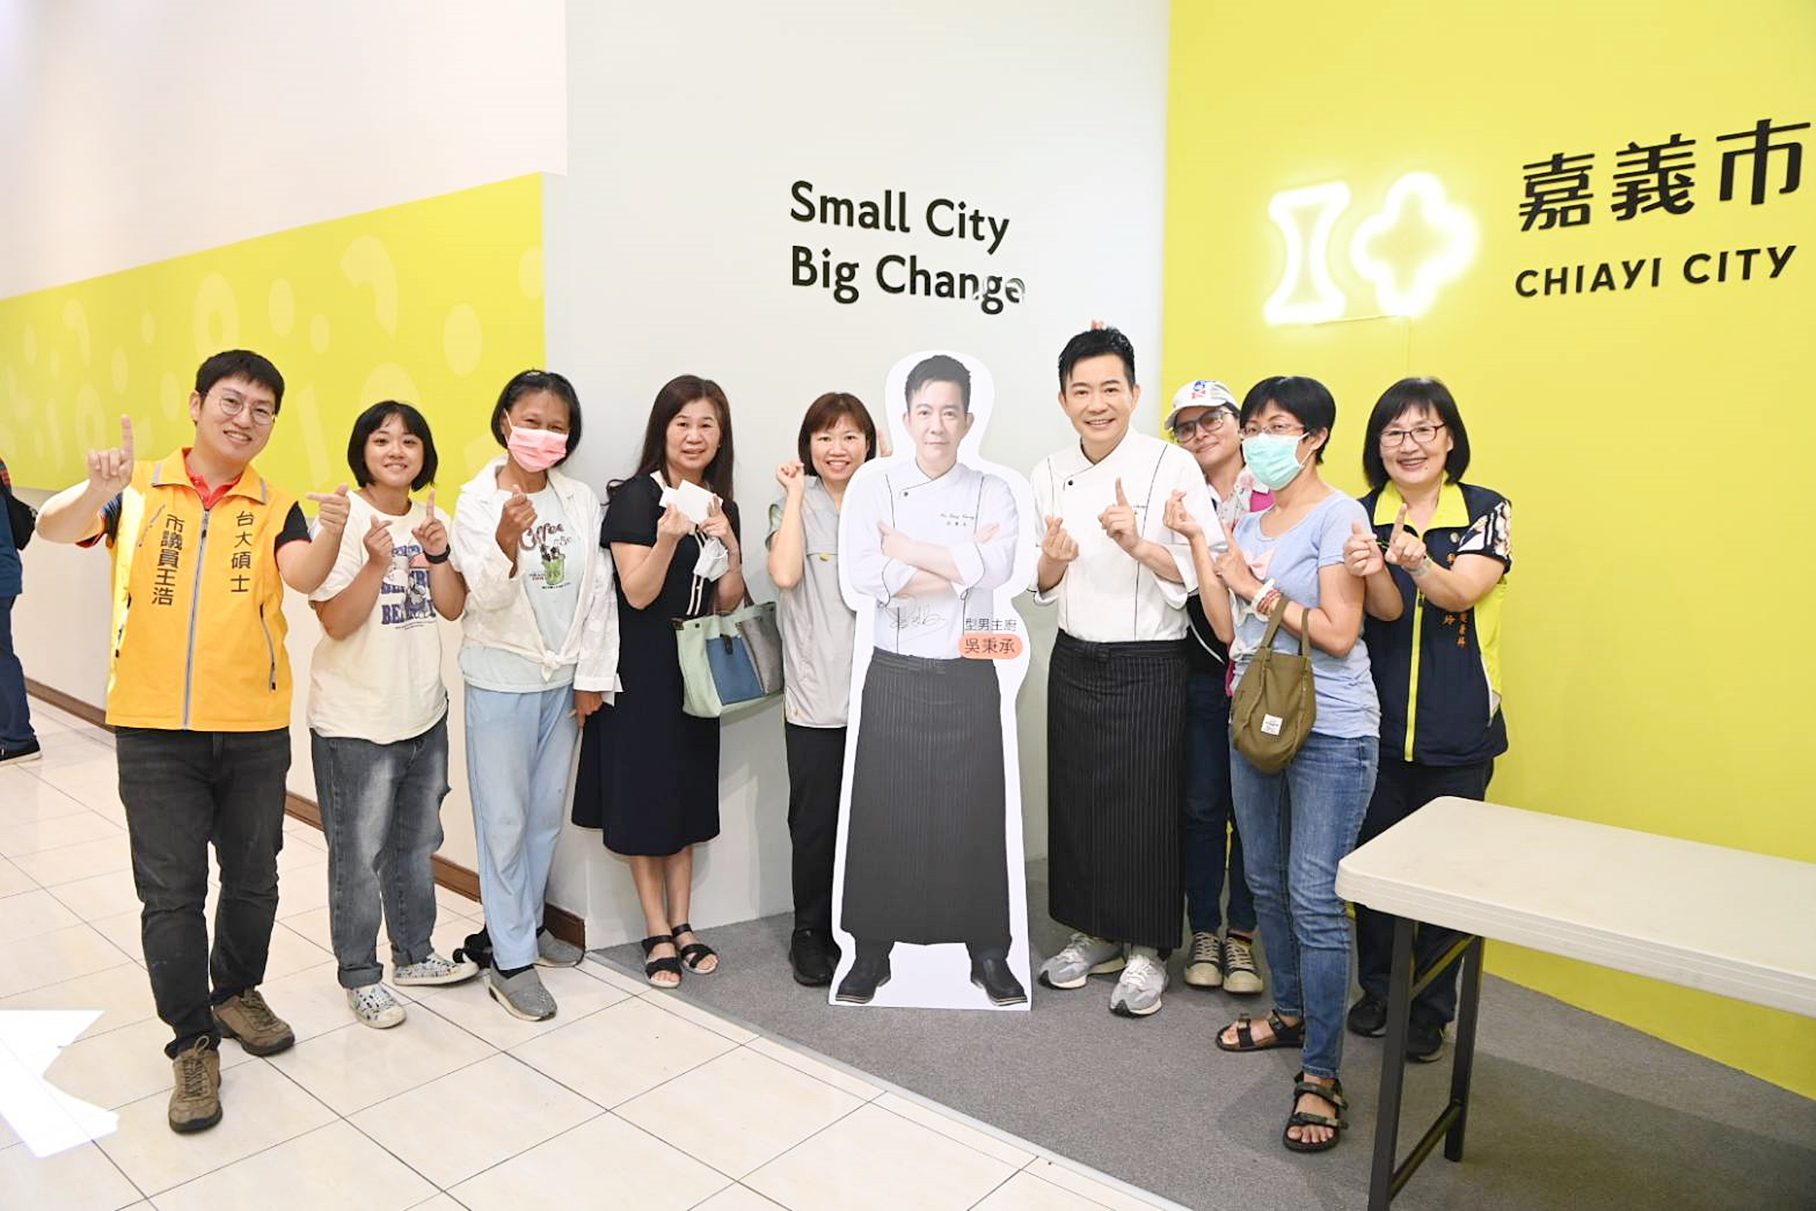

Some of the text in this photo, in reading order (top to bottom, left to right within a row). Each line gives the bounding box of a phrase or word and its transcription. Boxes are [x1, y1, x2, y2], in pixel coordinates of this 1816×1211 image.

[1519, 118, 1811, 232] 嘉義市
[790, 180, 1010, 255] Small City
[791, 245, 1026, 316] Big Change
[1515, 245, 1797, 298] CHIAYI CITY
[152, 514, 185, 606] 市議員王浩
[230, 511, 255, 593] 台大碩士
[965, 637, 1015, 654] 吳秉承
